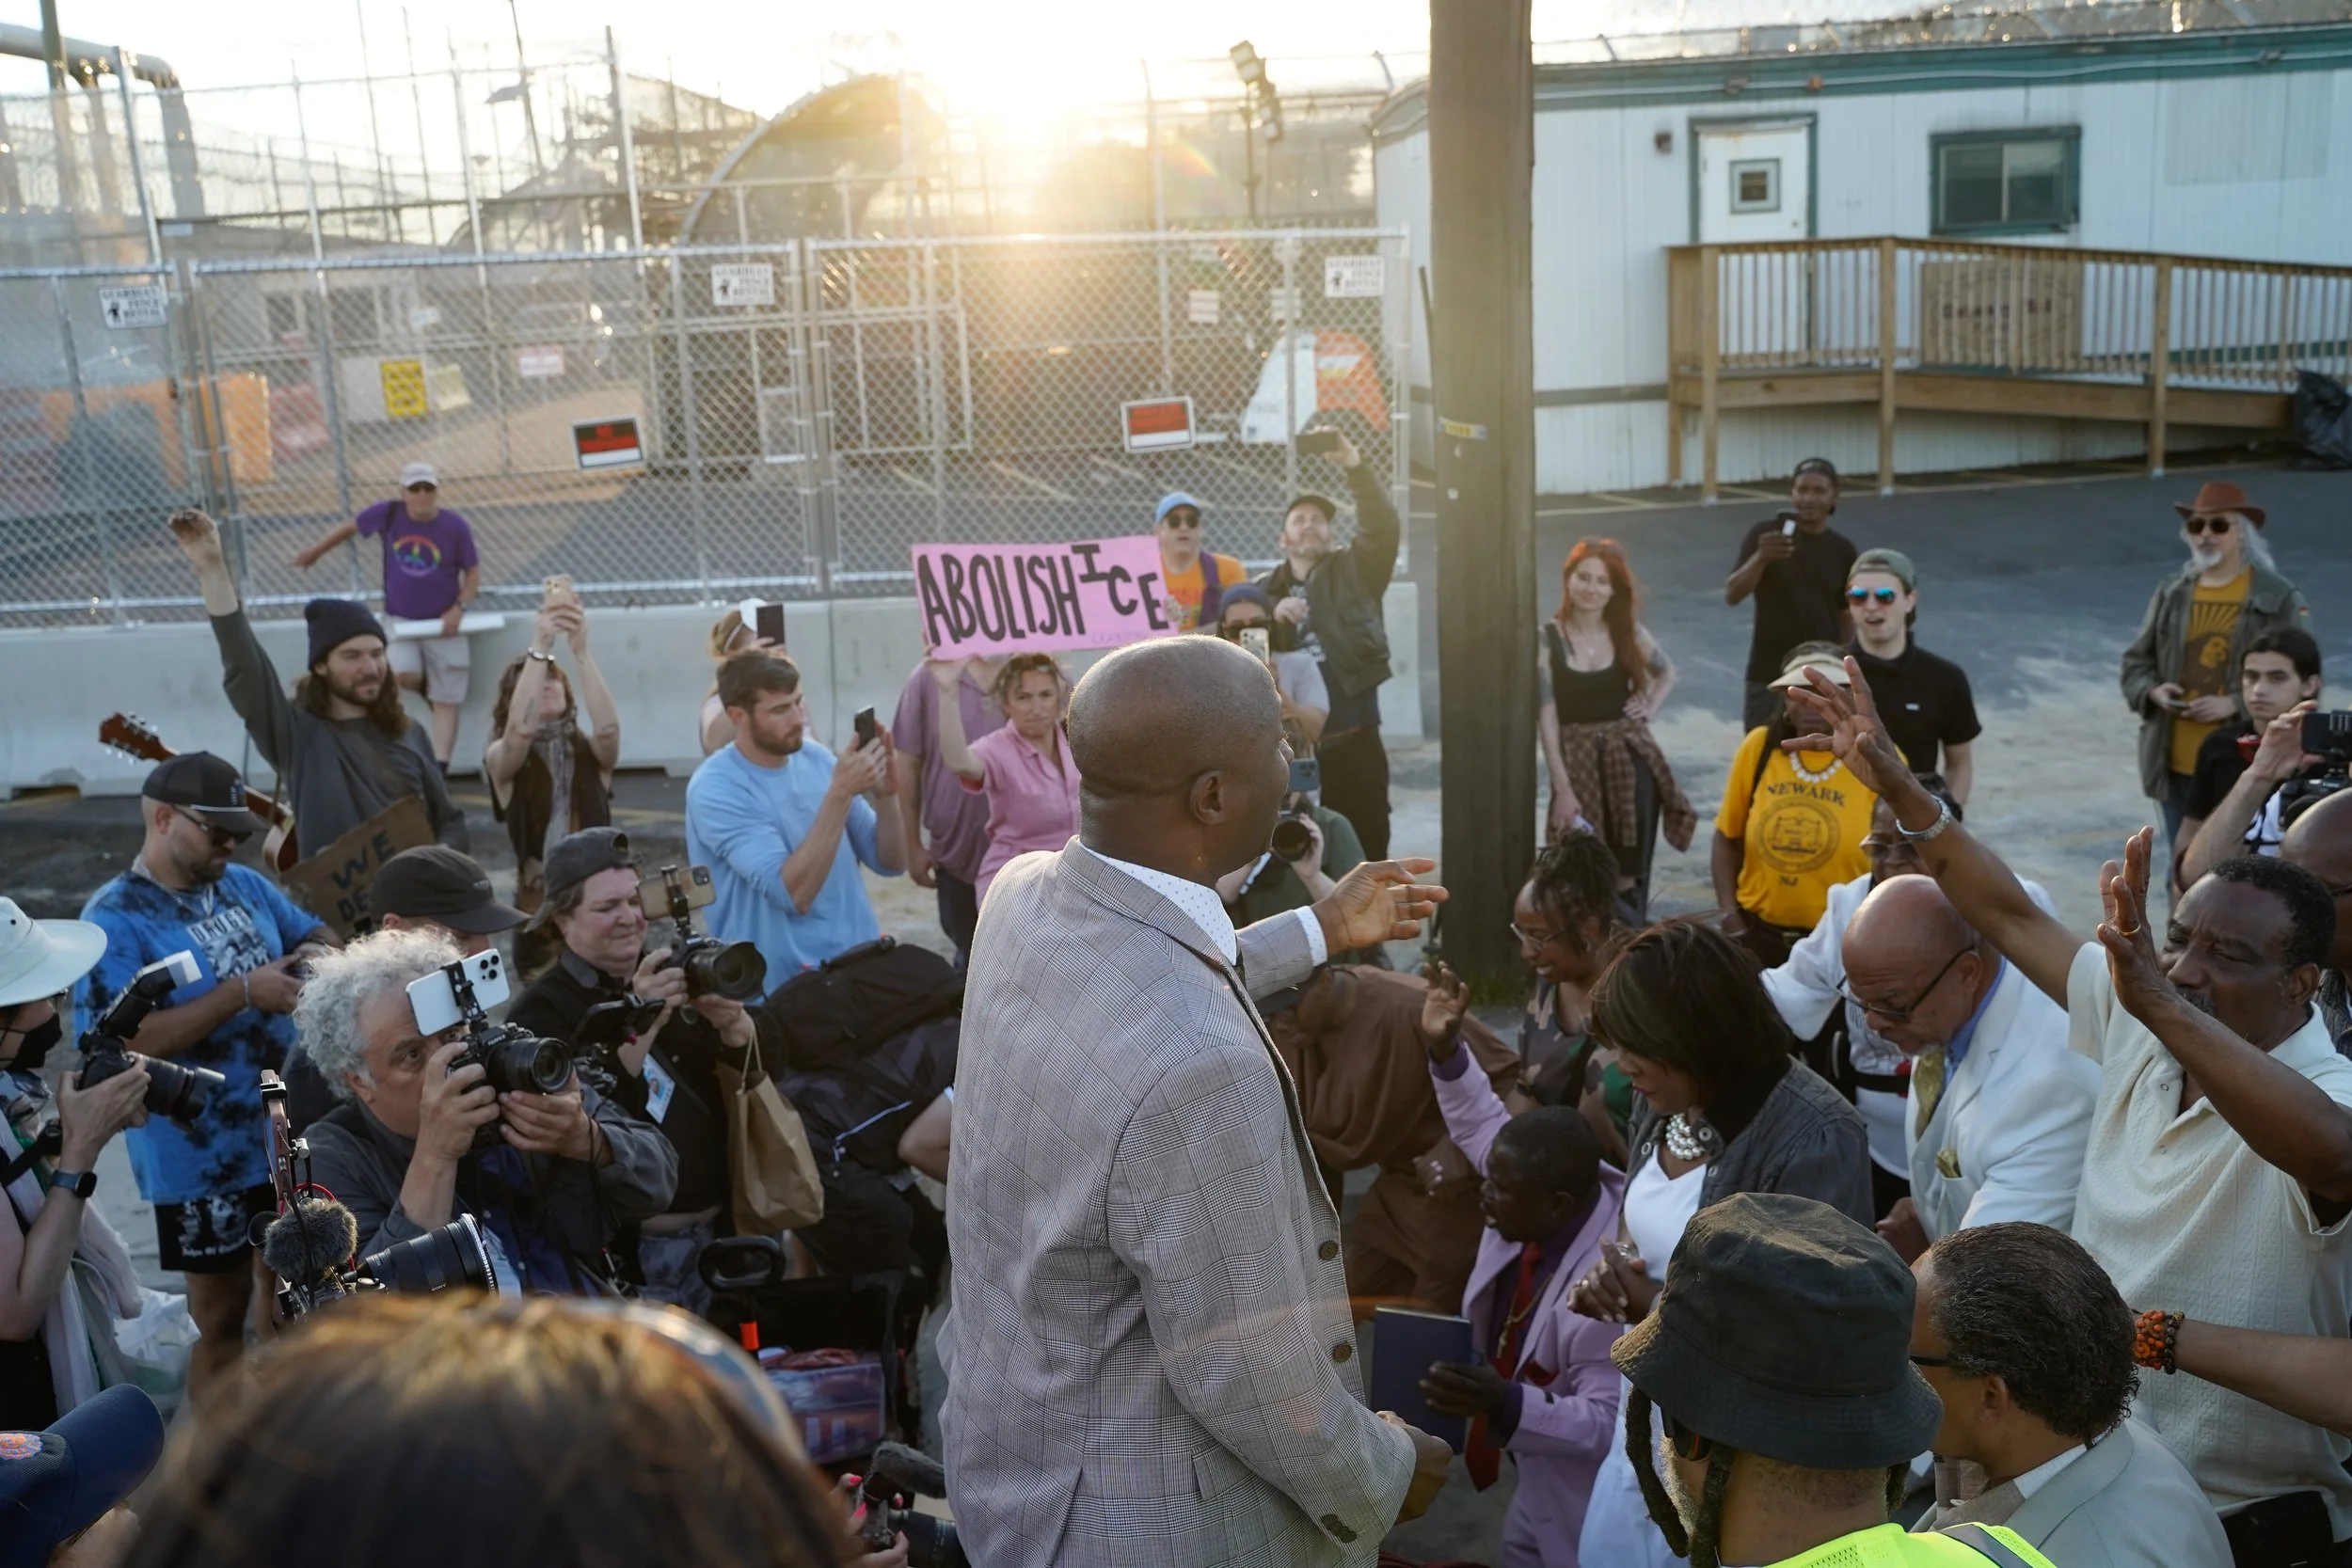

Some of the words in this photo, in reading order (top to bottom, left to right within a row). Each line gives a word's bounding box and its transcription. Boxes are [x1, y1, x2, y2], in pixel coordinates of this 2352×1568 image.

[917, 552, 1086, 646] ABOLISH
[1071, 544, 1169, 630] ICE
[1767, 782, 1845, 807] NEWARK
[331, 830, 396, 890] WE
